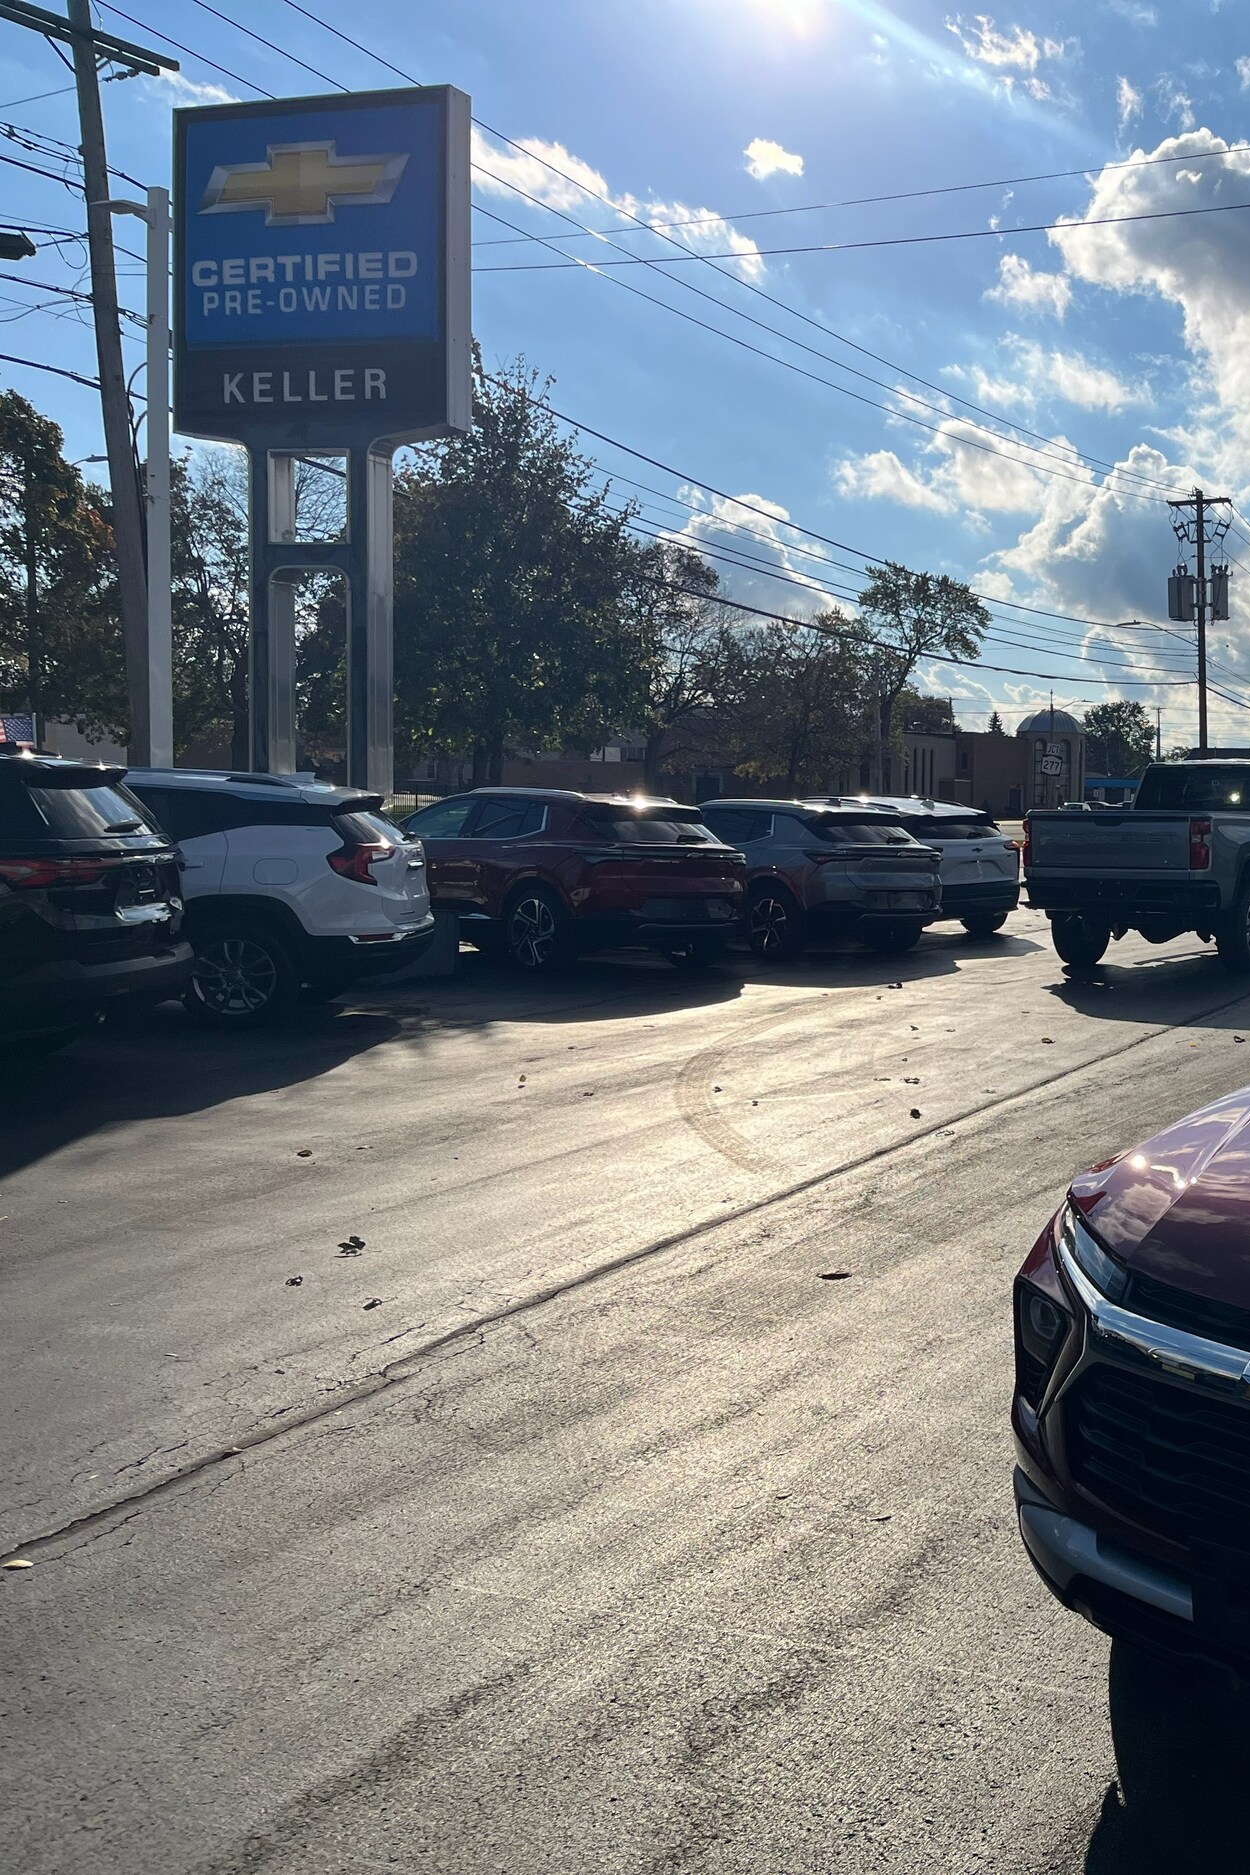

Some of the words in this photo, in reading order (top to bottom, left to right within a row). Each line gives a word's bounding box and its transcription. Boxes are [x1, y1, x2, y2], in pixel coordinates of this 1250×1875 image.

[191, 250, 418, 287] CERTIFIED
[203, 284, 406, 316] PRE-OWNED
[223, 368, 387, 404] KELLER
[1043, 760, 1060, 771] 277
[1047, 745, 1060, 754] JCT
